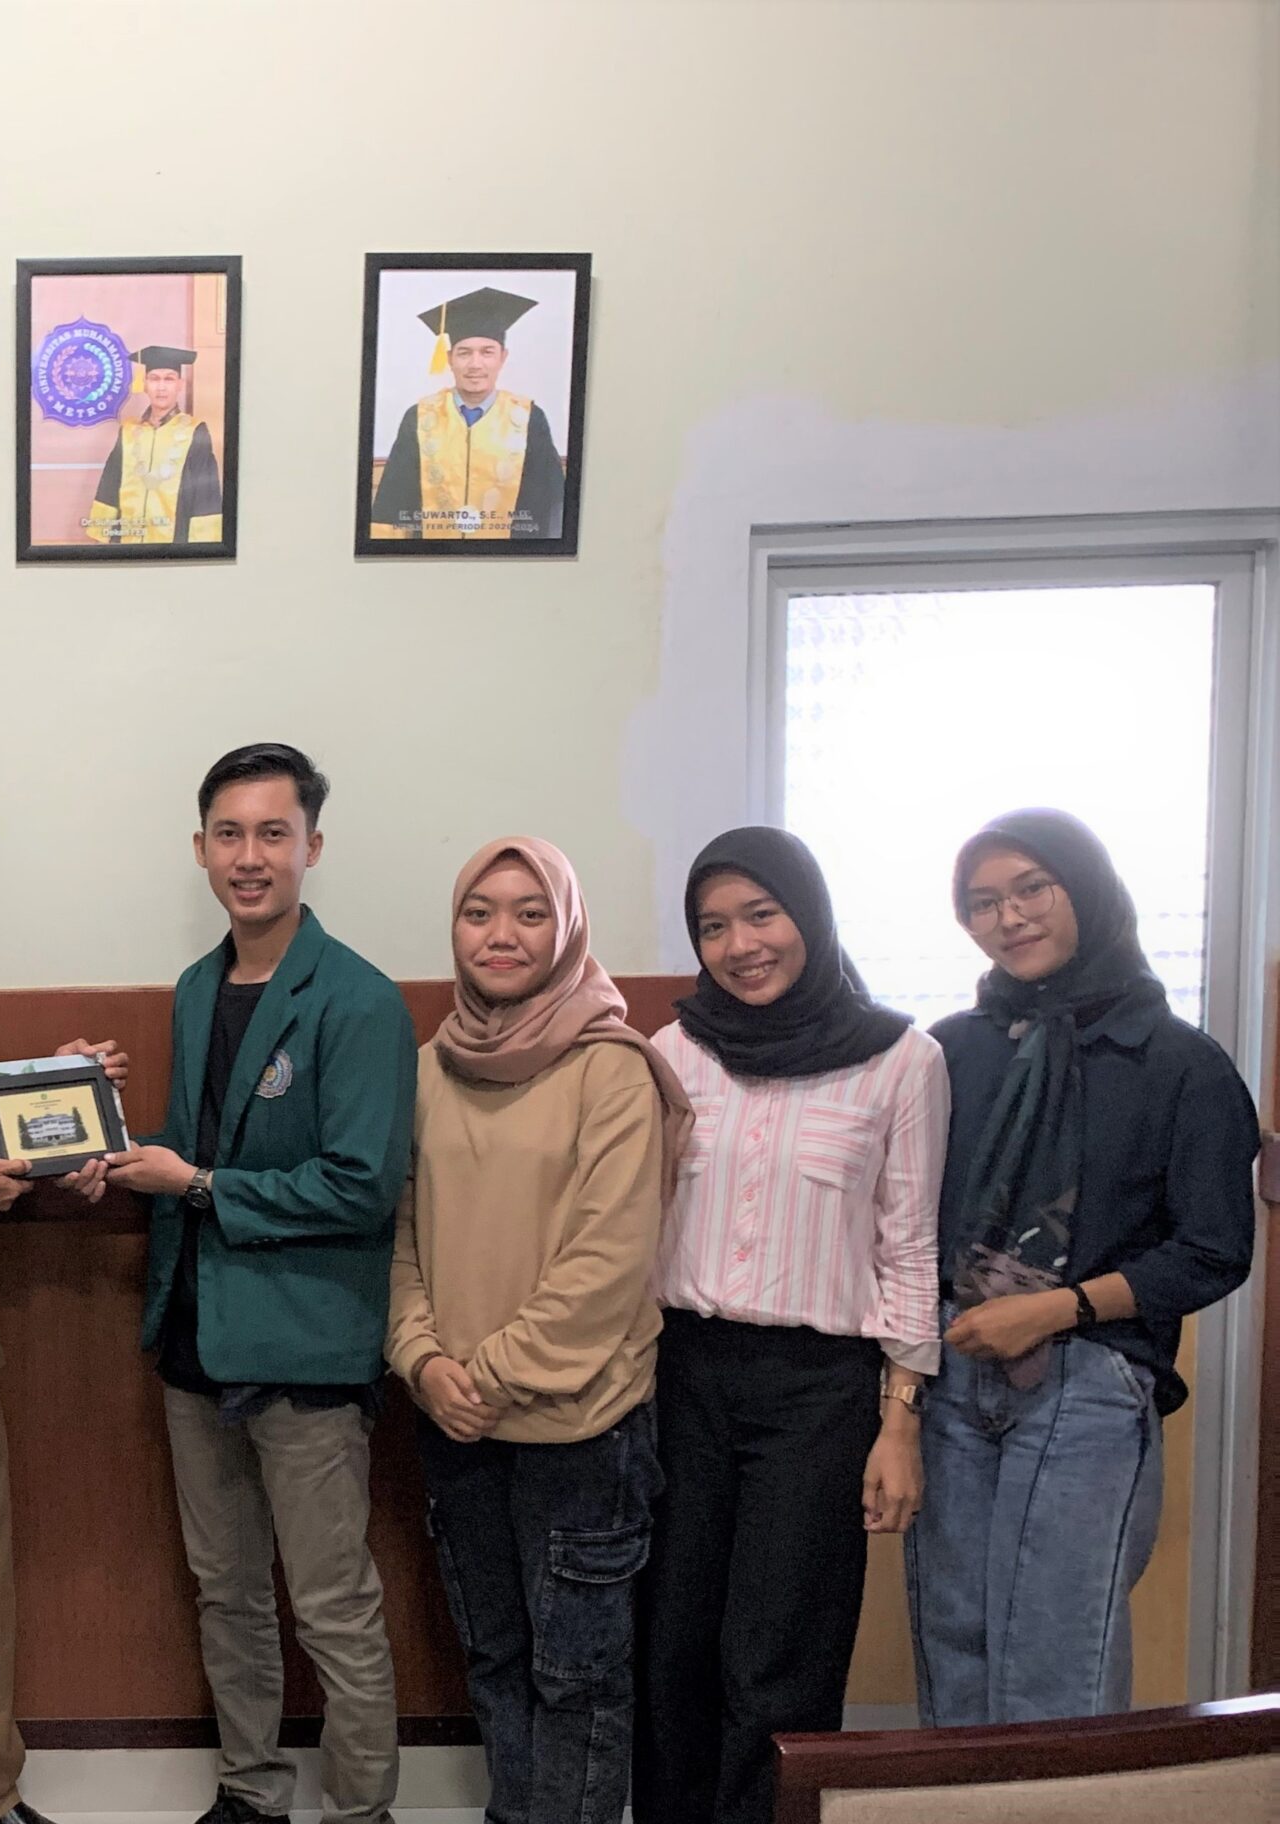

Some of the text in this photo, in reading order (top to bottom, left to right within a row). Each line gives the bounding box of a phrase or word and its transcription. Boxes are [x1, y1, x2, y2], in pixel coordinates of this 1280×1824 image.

[38, 328, 124, 395] UNIVERSITAS MUHAMMADIYAH
[51, 401, 107, 418] METRO
[445, 522, 486, 531] PERIODE
